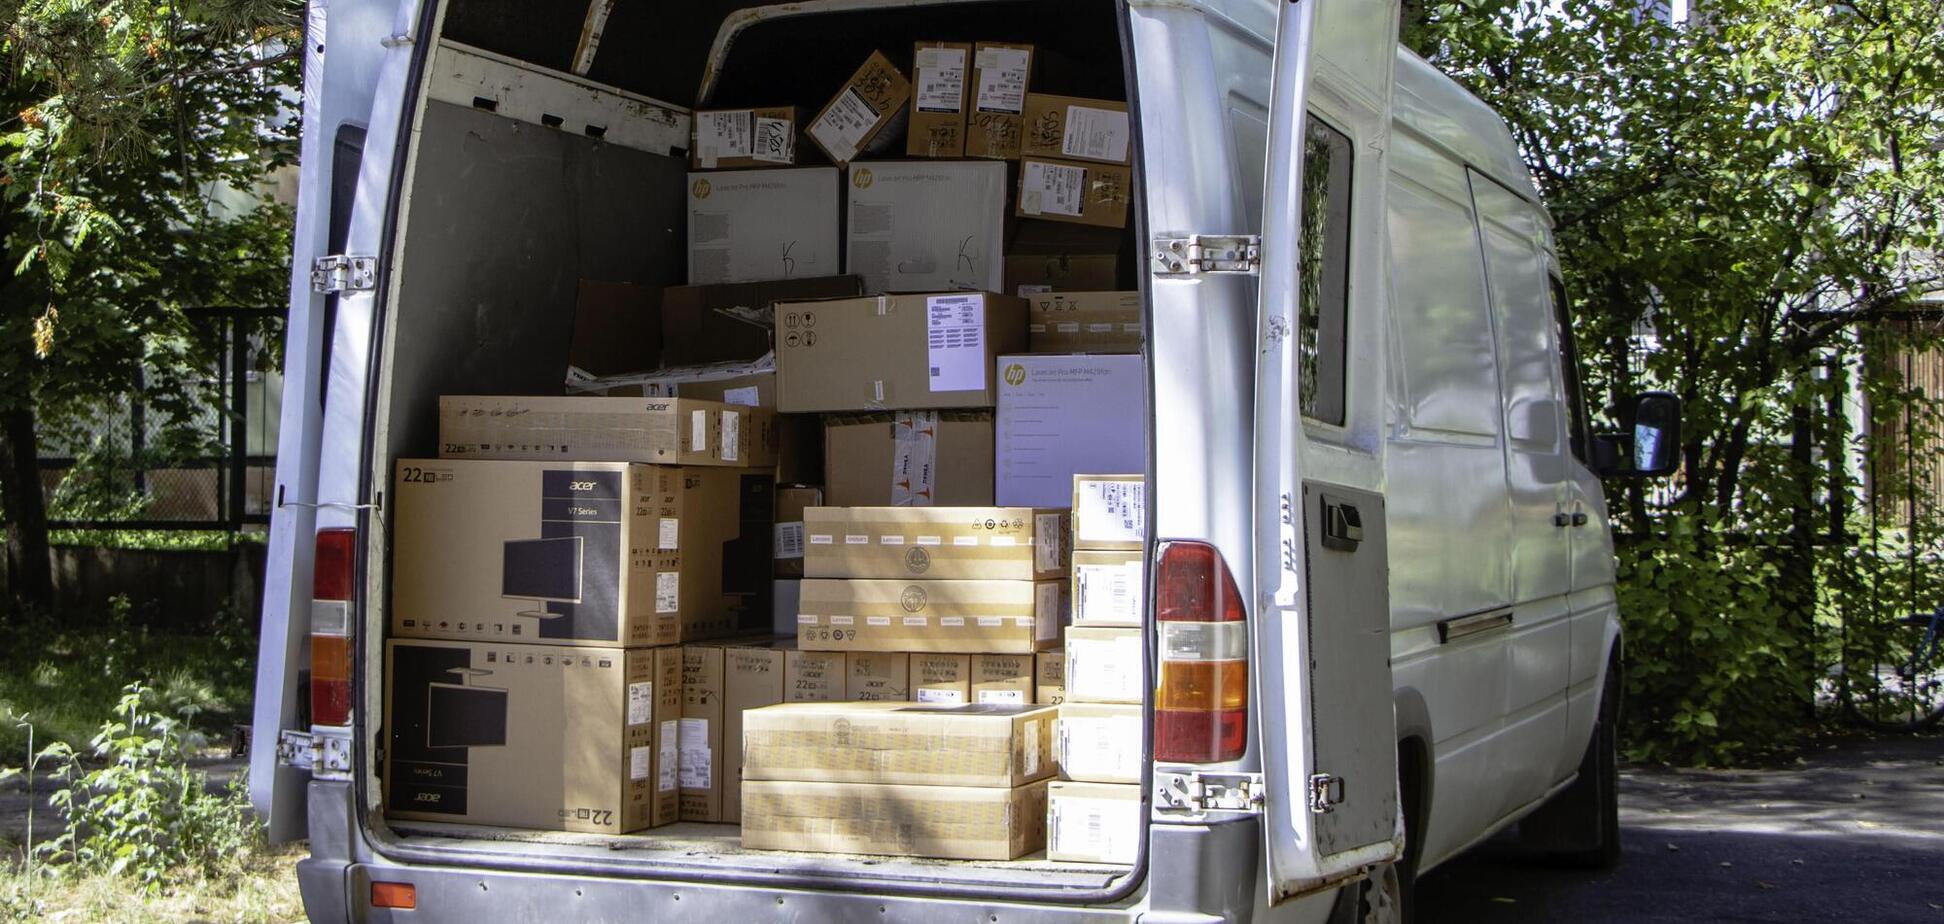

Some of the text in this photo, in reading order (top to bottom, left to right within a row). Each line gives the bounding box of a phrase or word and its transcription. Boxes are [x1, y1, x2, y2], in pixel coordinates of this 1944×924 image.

[853, 168, 872, 188] hp
[694, 179, 711, 199] hp
[957, 234, 974, 273] K
[1004, 363, 1026, 386] hp
[646, 402, 670, 411] acer
[403, 467, 422, 482] 22
[569, 481, 597, 491] acer
[568, 507, 597, 516] V7 Series
[796, 680, 808, 689] 22
[859, 692, 871, 701] 22
[1051, 695, 1064, 705] 22
[413, 792, 441, 802] acer
[592, 810, 612, 826] 22
